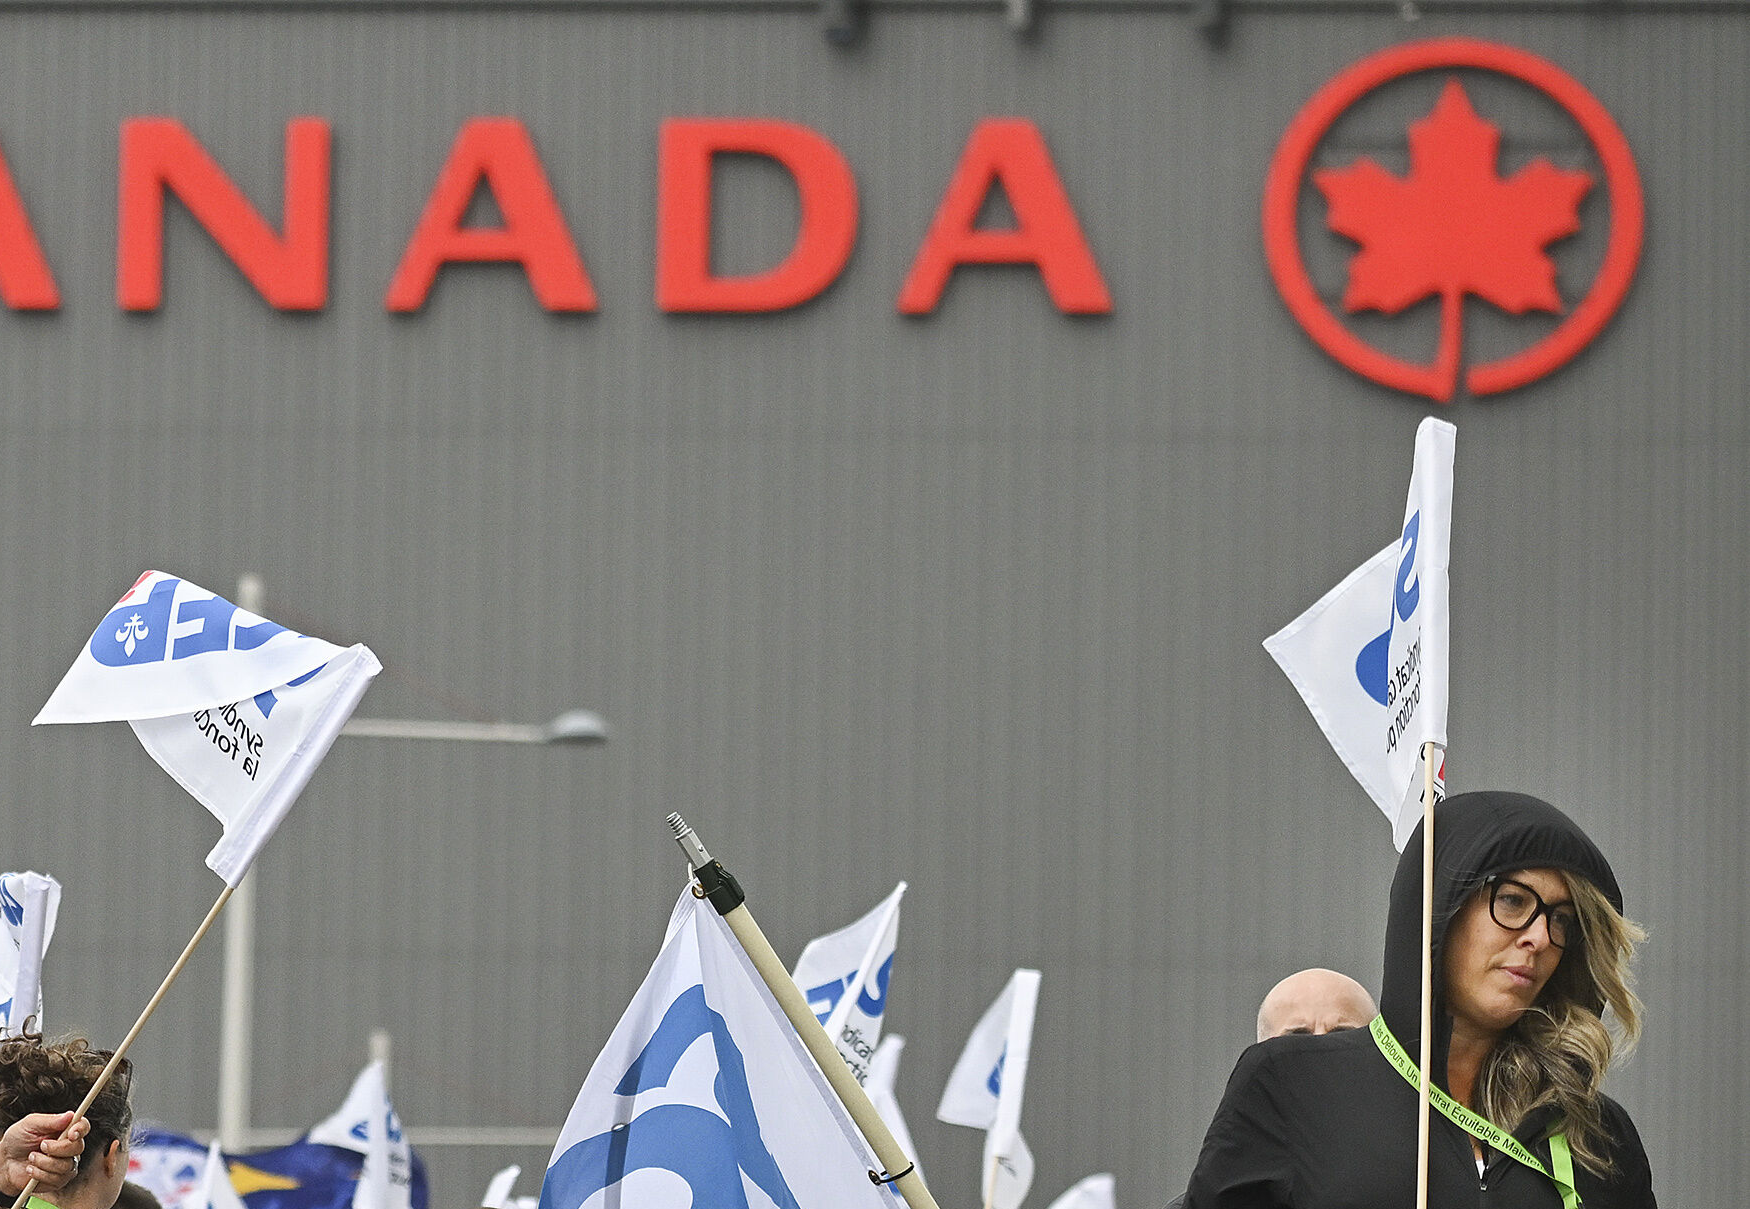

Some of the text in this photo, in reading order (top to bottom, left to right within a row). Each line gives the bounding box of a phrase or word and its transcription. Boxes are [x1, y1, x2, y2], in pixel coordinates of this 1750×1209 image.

[842, 1024, 874, 1065] dicat
[1381, 1034, 1405, 1071] Détours.
[1406, 1064, 1418, 1083] Un
[1451, 1104, 1501, 1144] Équitable
